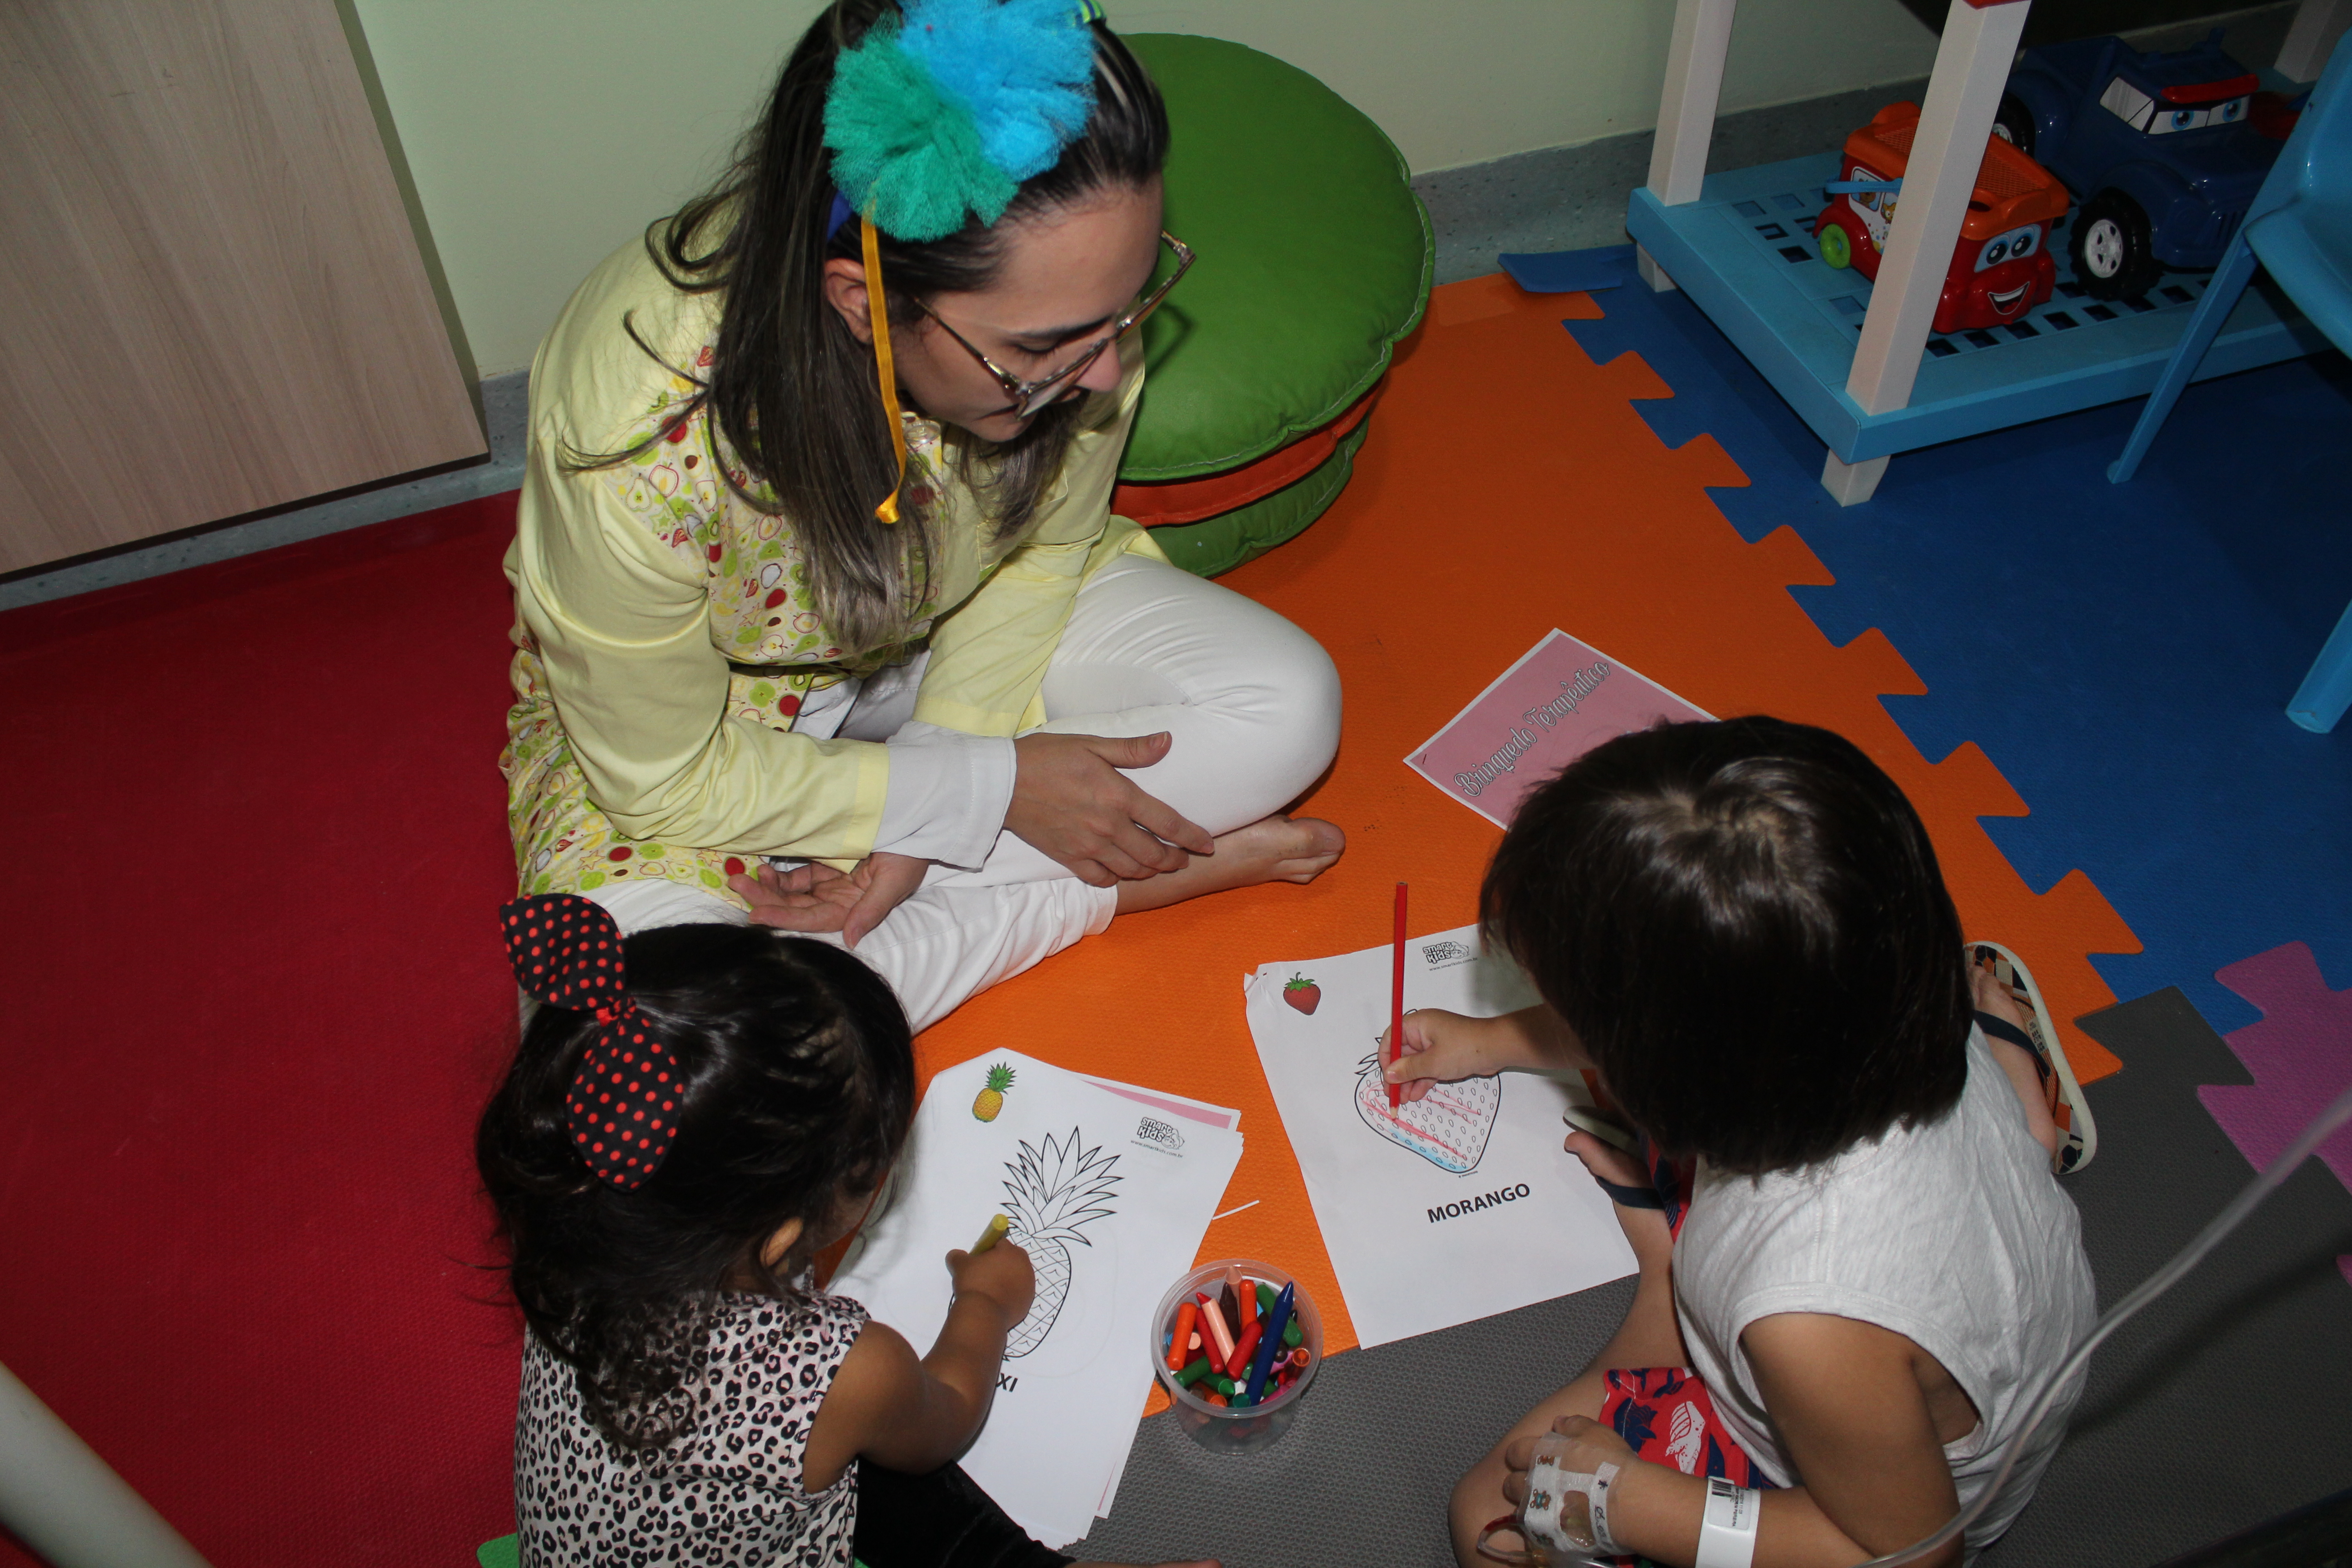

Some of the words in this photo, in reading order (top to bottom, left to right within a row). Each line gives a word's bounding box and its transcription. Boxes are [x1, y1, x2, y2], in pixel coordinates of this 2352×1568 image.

[1454, 727, 1537, 797] Brinquedo
[1523, 661, 1610, 732] Terapêutico
[1131, 1140, 1183, 1157] www.smartkids.com.br
[1427, 1184, 1529, 1223] MORANGO
[995, 1373, 1018, 1392] XI
